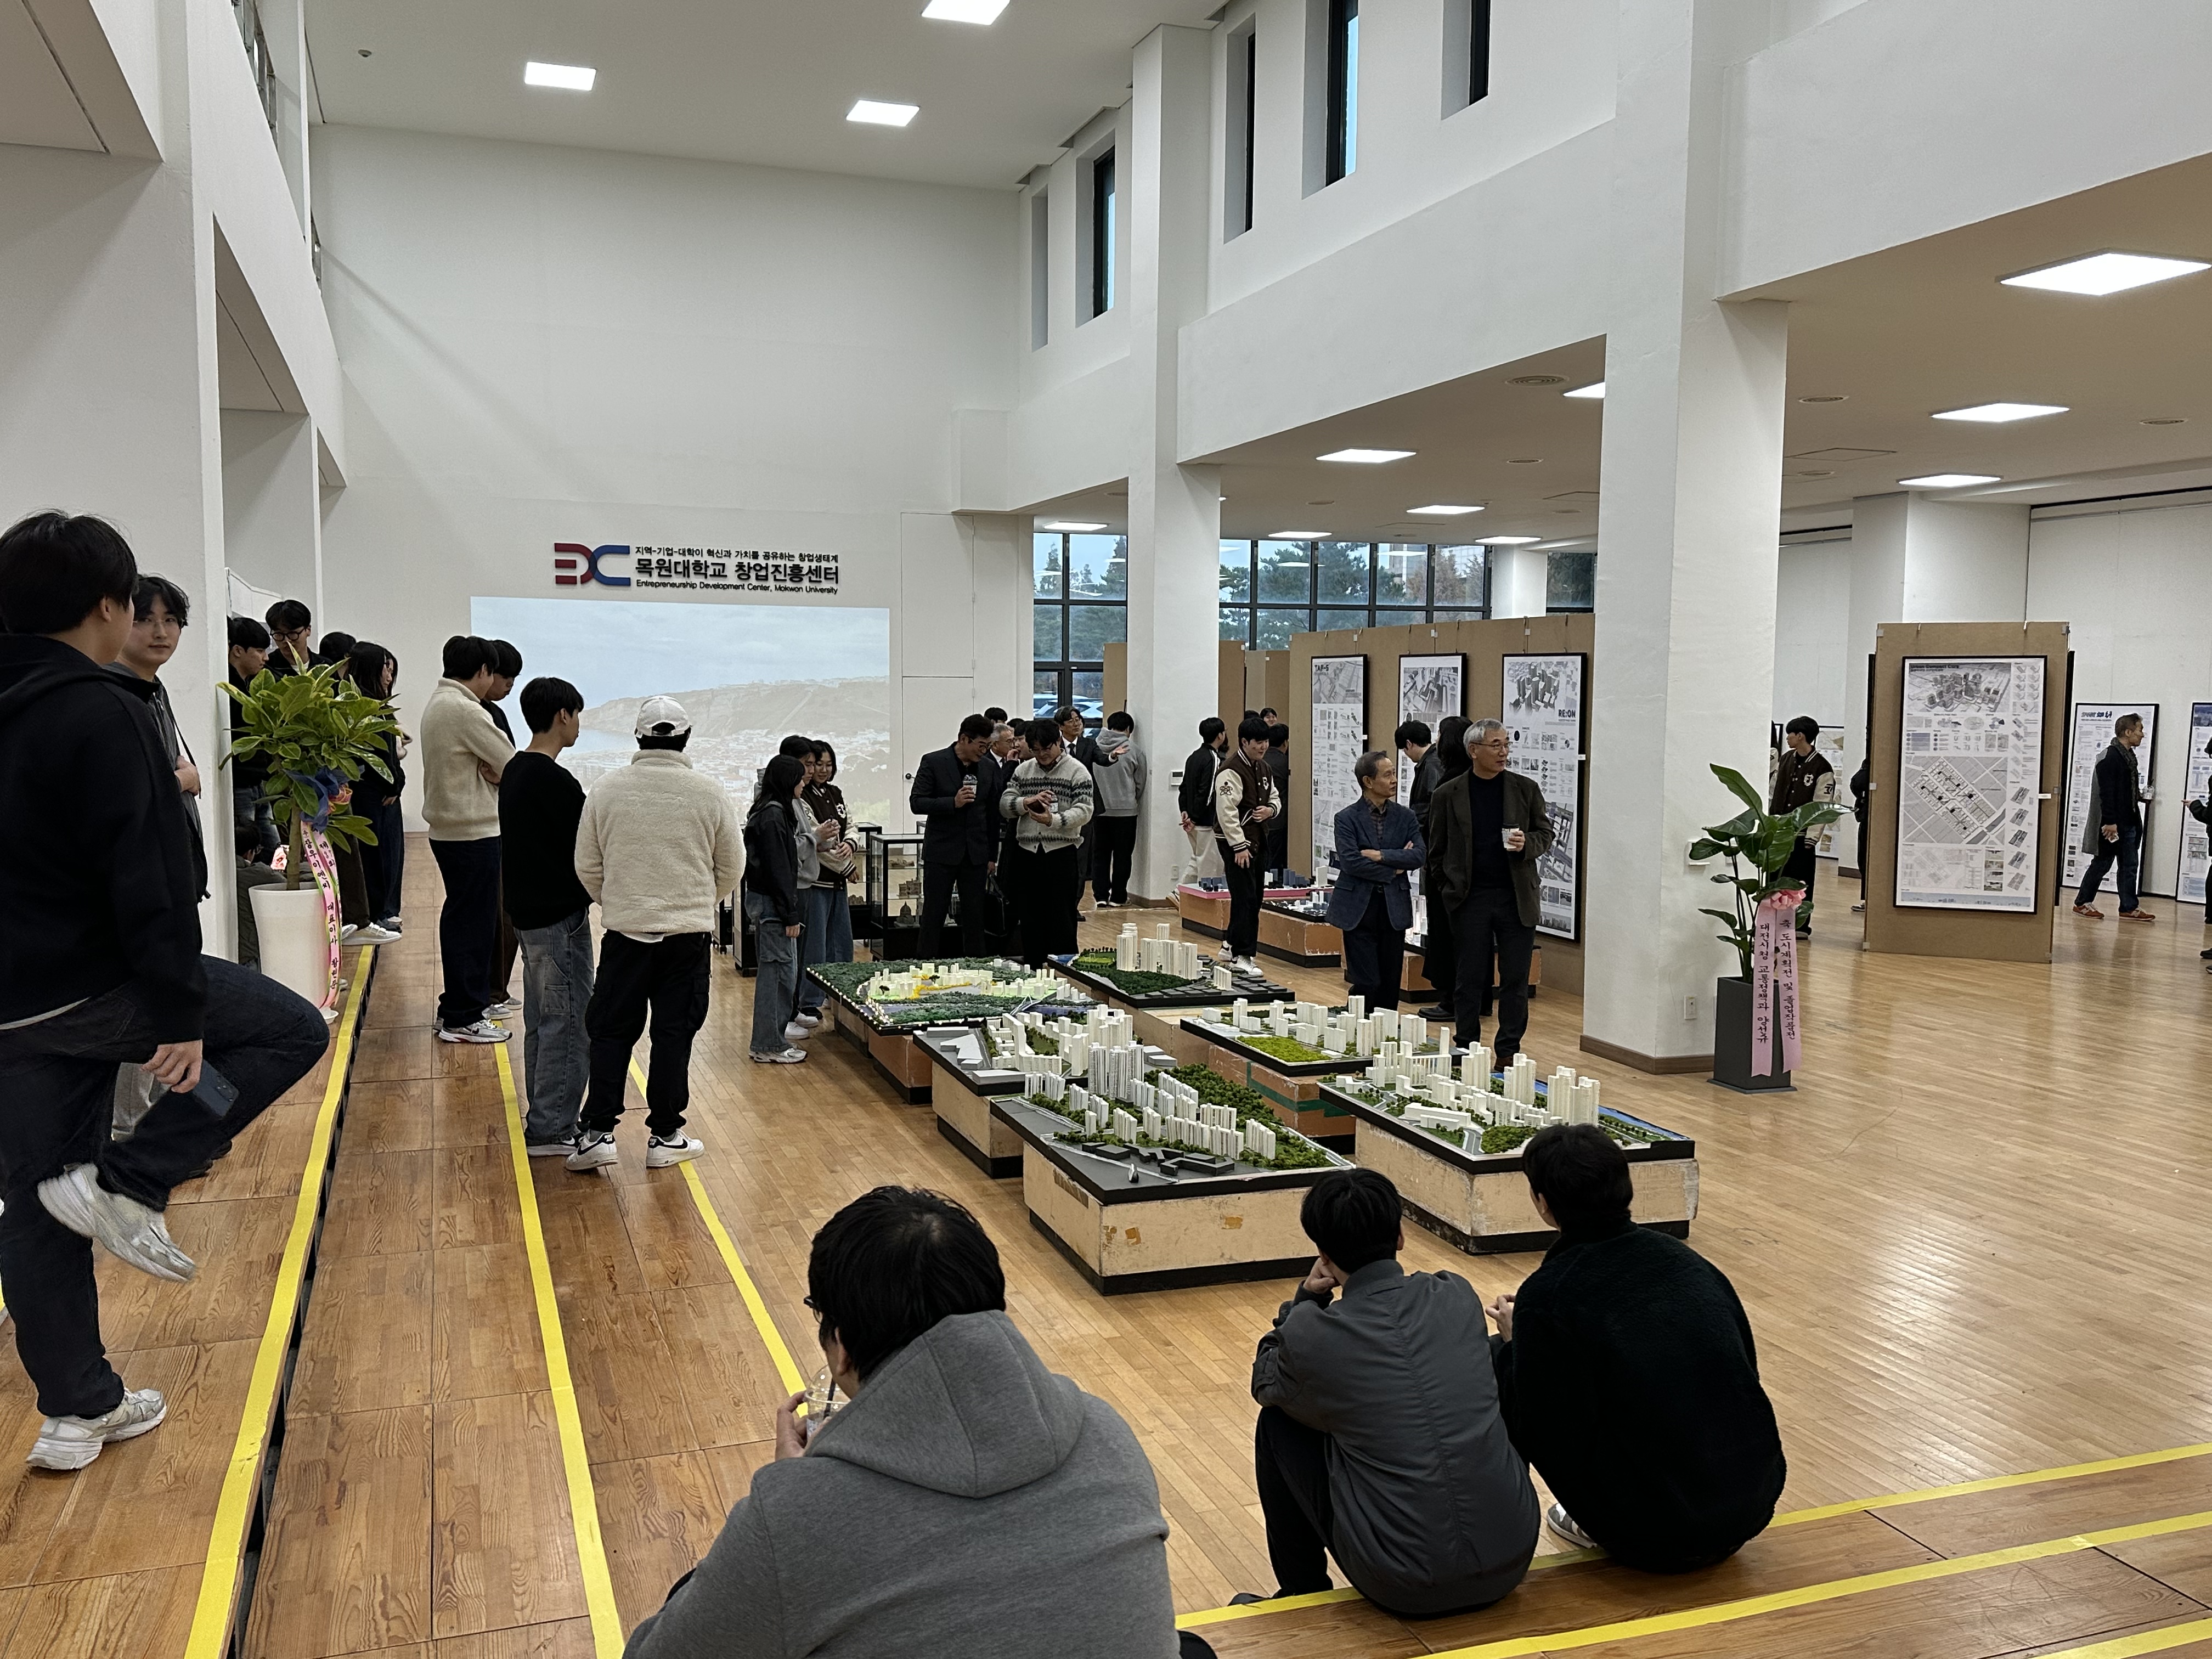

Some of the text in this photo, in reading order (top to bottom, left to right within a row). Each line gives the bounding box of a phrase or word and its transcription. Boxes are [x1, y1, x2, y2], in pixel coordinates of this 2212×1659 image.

[635, 546, 838, 563] 지역-기업-대학이 혁신과 가치를 공유하는 창업생태계
[635, 558, 839, 584] 목원대학교 창업진흥센터
[636, 579, 697, 589] Entrepreneurship
[699, 582, 745, 590] Development
[805, 586, 838, 595] University
[1558, 709, 1576, 718] RE:ON
[328, 902, 338, 945] 대표이사
[1758, 923, 1770, 961] 대전시청
[1780, 933, 1792, 978] 도시계획전
[1757, 966, 1770, 1011] 교통정책과
[1783, 981, 1793, 991] 및
[1784, 995, 1796, 1040] 졸업작품전
